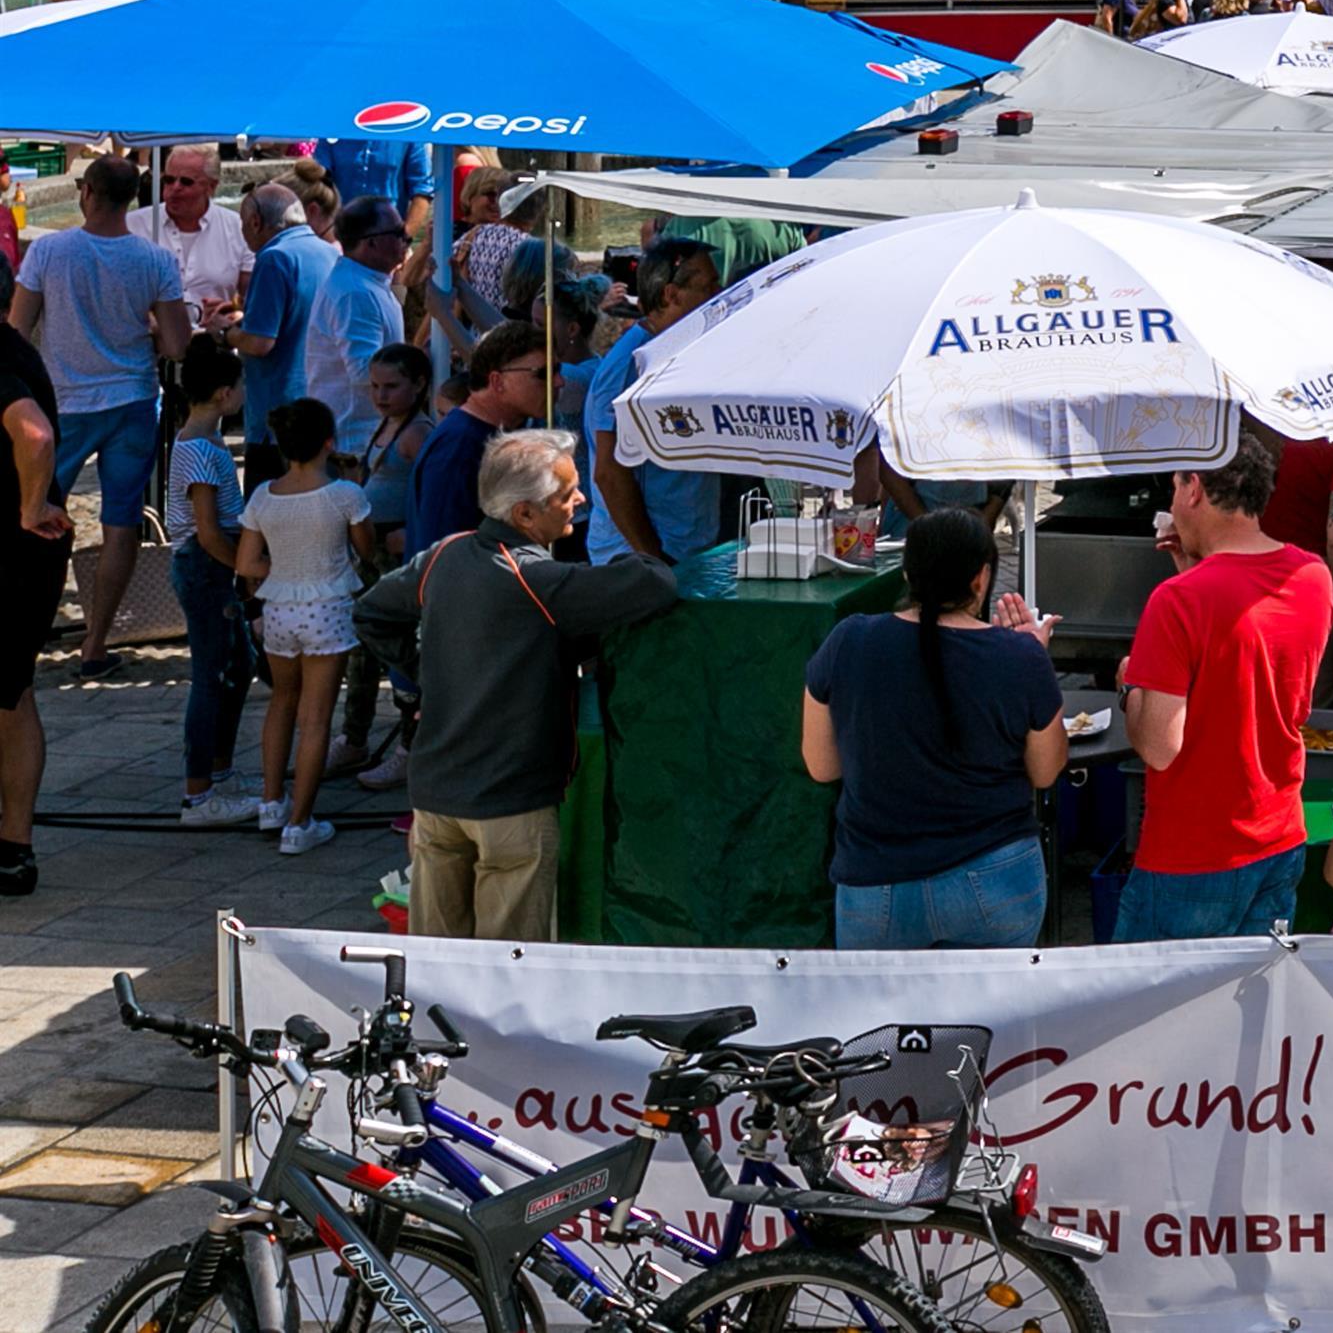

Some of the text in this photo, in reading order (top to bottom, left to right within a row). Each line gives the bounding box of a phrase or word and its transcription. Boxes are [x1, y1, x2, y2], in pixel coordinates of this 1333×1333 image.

[431, 109, 585, 138] pepsi
[925, 307, 1182, 358] ALLGÄUER
[979, 331, 1134, 353] BRAUHAUS
[711, 403, 820, 443] ALLGÄUER
[734, 424, 801, 442] BRAUHAUS
[969, 1033, 1324, 1147] Grund!
[1143, 1213, 1327, 1257] GMBH
